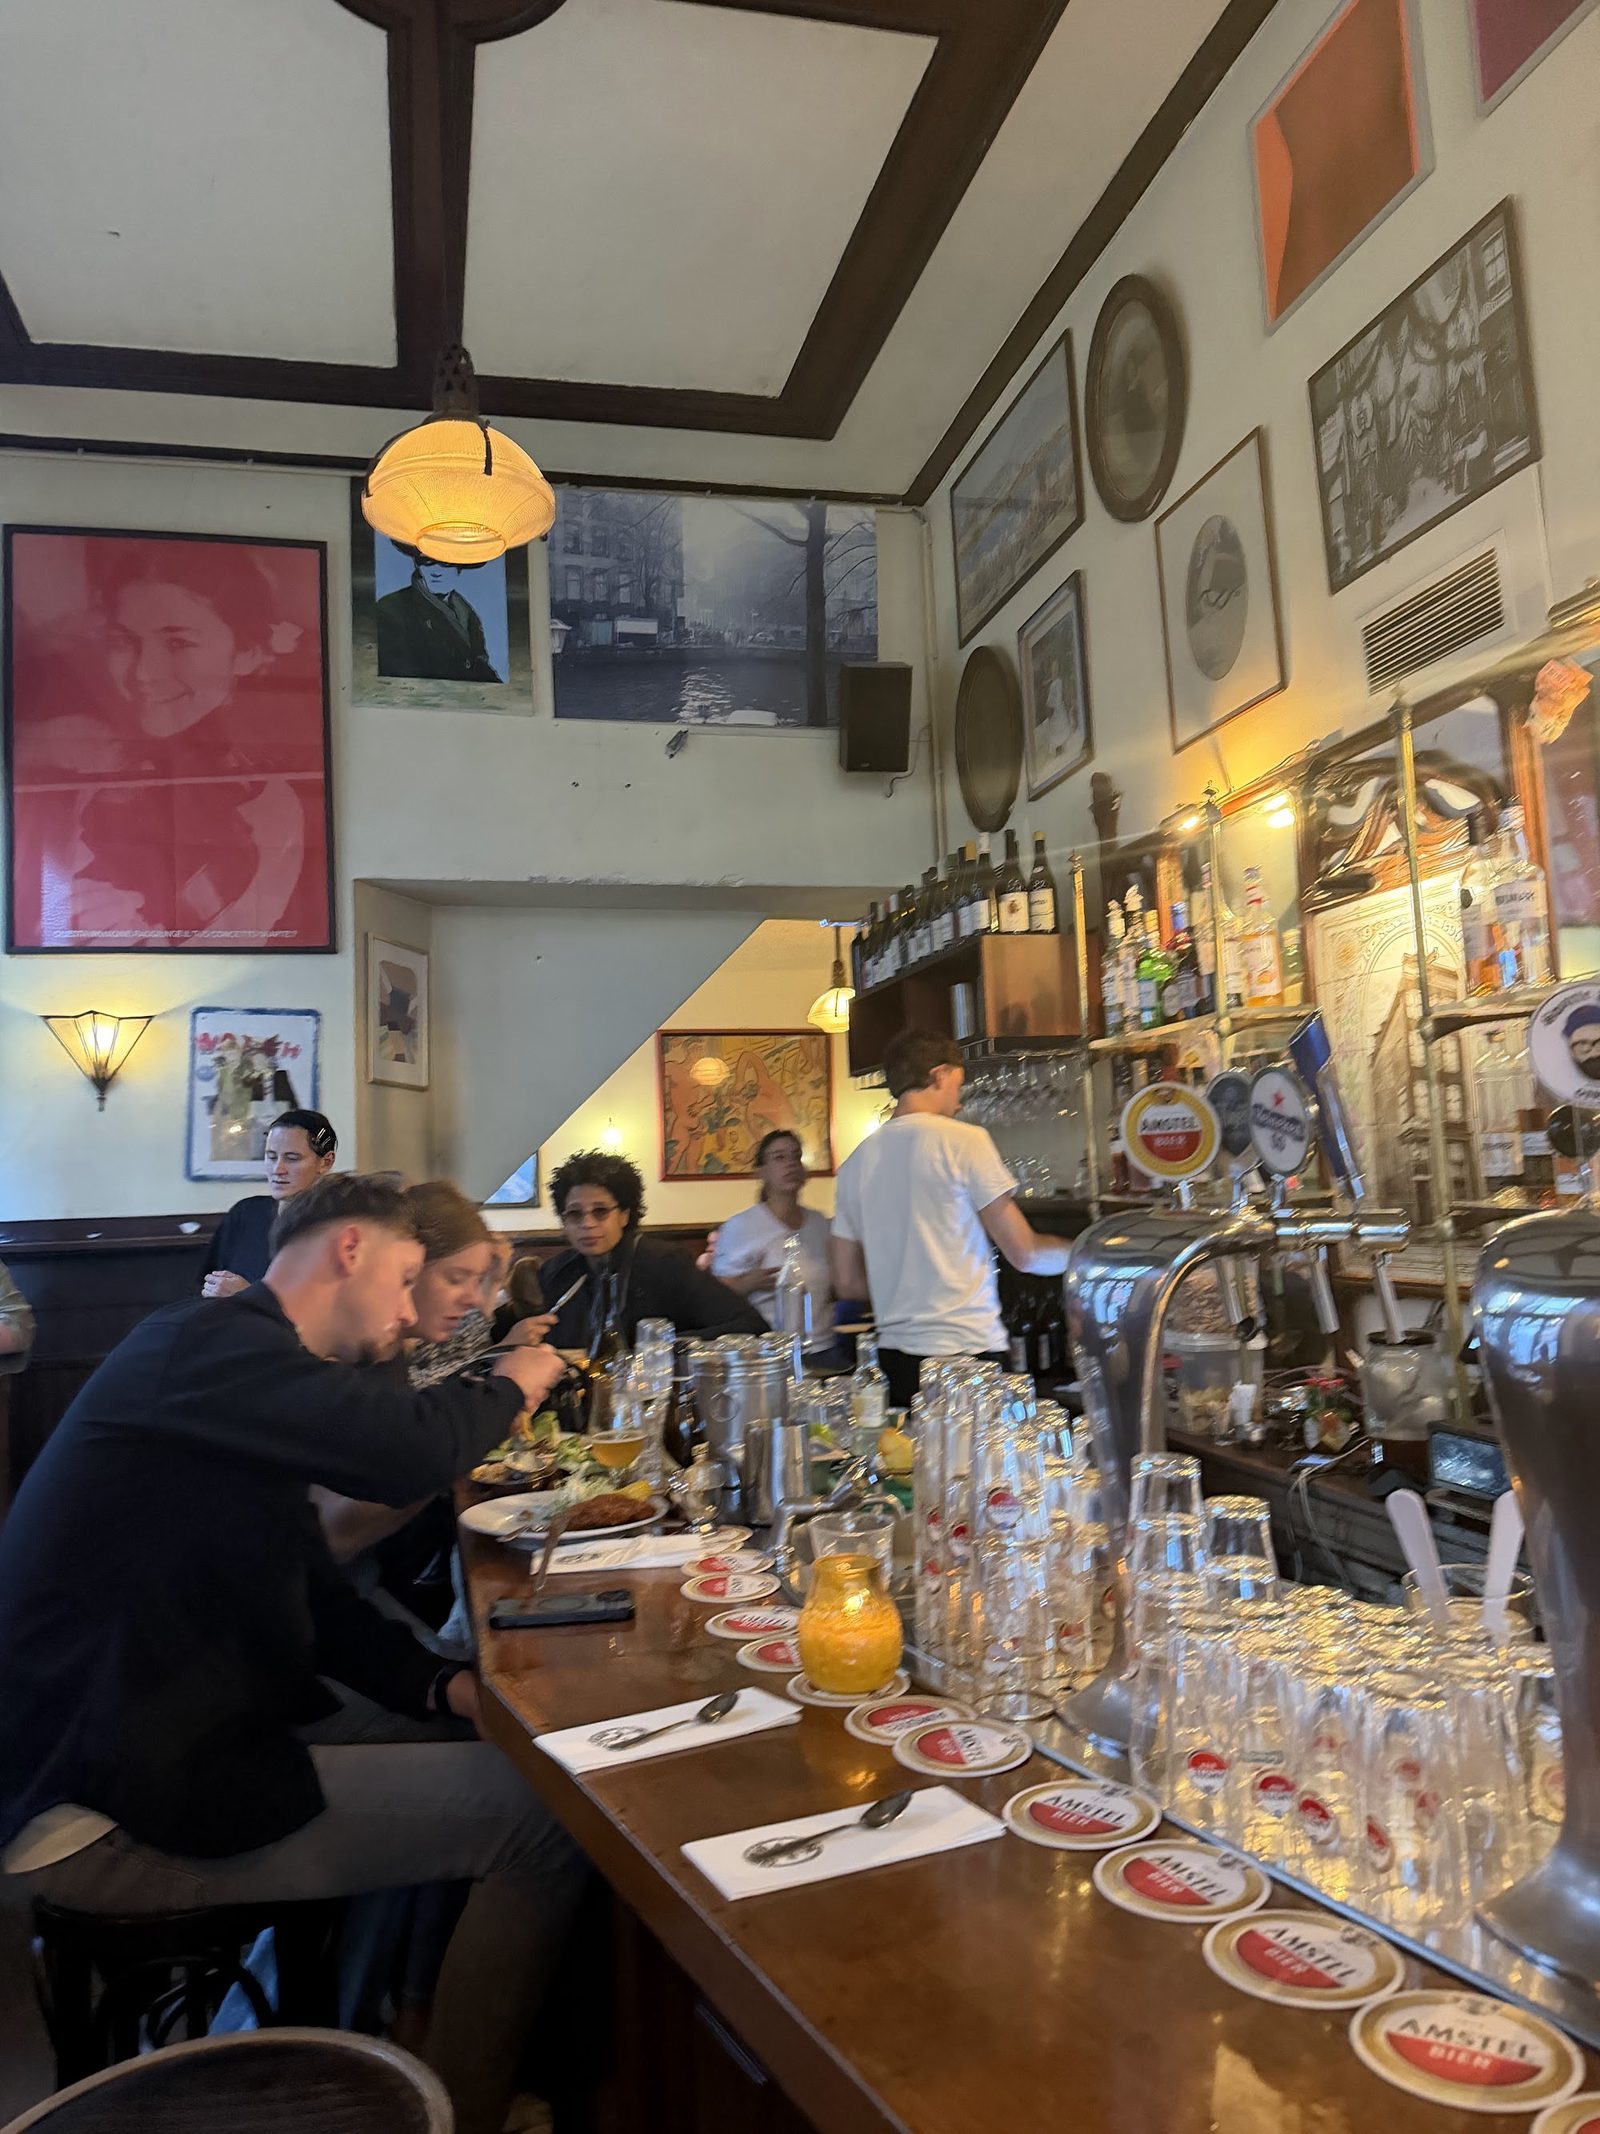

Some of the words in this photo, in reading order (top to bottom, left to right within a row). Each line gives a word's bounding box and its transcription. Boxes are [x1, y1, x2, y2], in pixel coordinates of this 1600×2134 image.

[1139, 1115, 1199, 1132] AMSTEL
[1043, 1794, 1130, 1826] AMSTEL
[1051, 1810, 1091, 1826] BIER
[1150, 1856, 1229, 1901] AMSTEL
[1264, 1928, 1359, 1980] AMSTEL
[1399, 2018, 1535, 2063] AMSTEL
[1429, 2045, 1494, 2069] BIER
